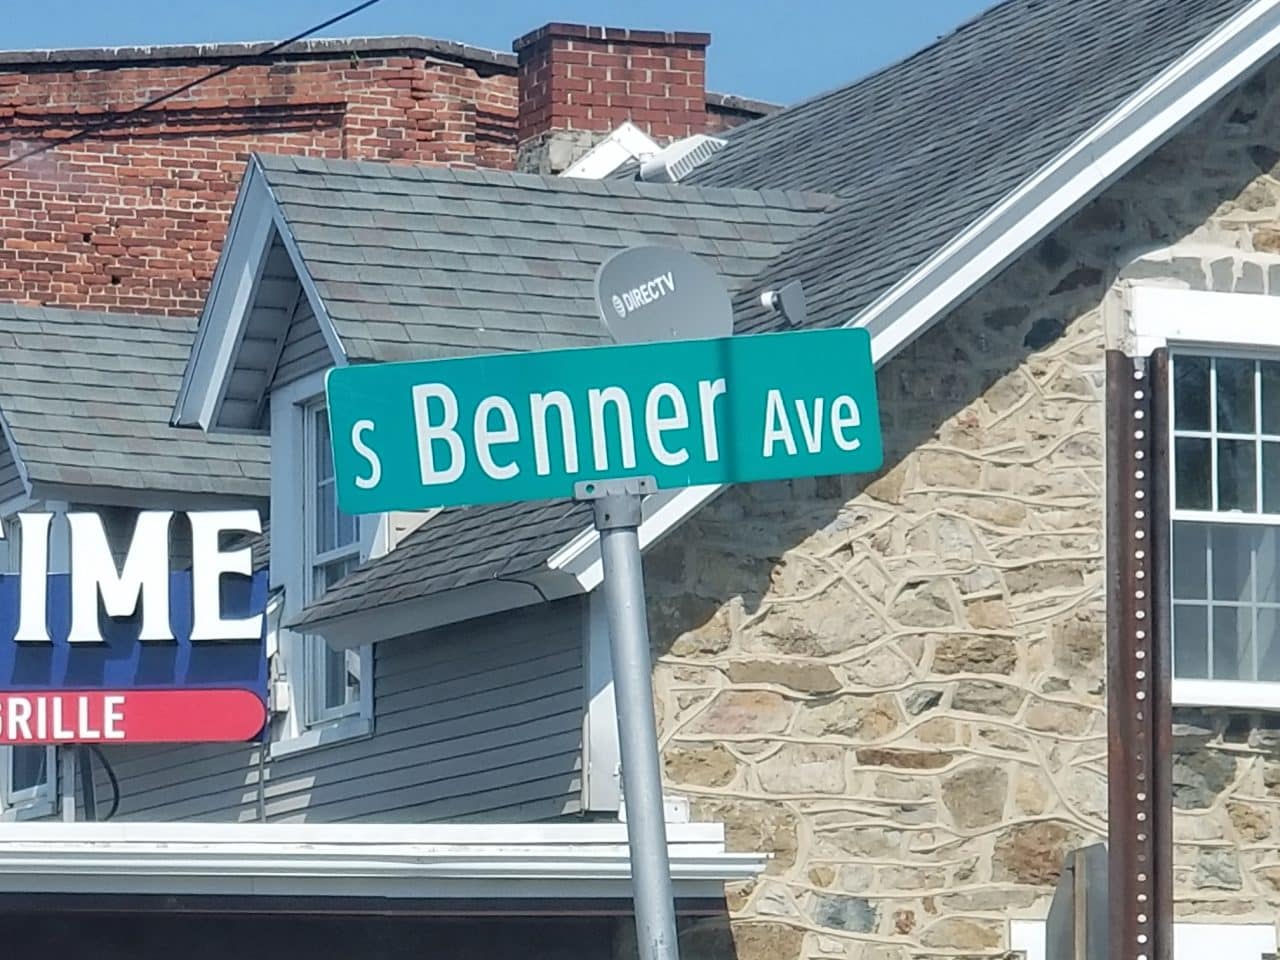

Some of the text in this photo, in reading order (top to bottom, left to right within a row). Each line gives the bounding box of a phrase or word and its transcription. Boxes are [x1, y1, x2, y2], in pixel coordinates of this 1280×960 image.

[622, 271, 676, 312] DIRECTV
[351, 376, 862, 489] S Benner Ave
